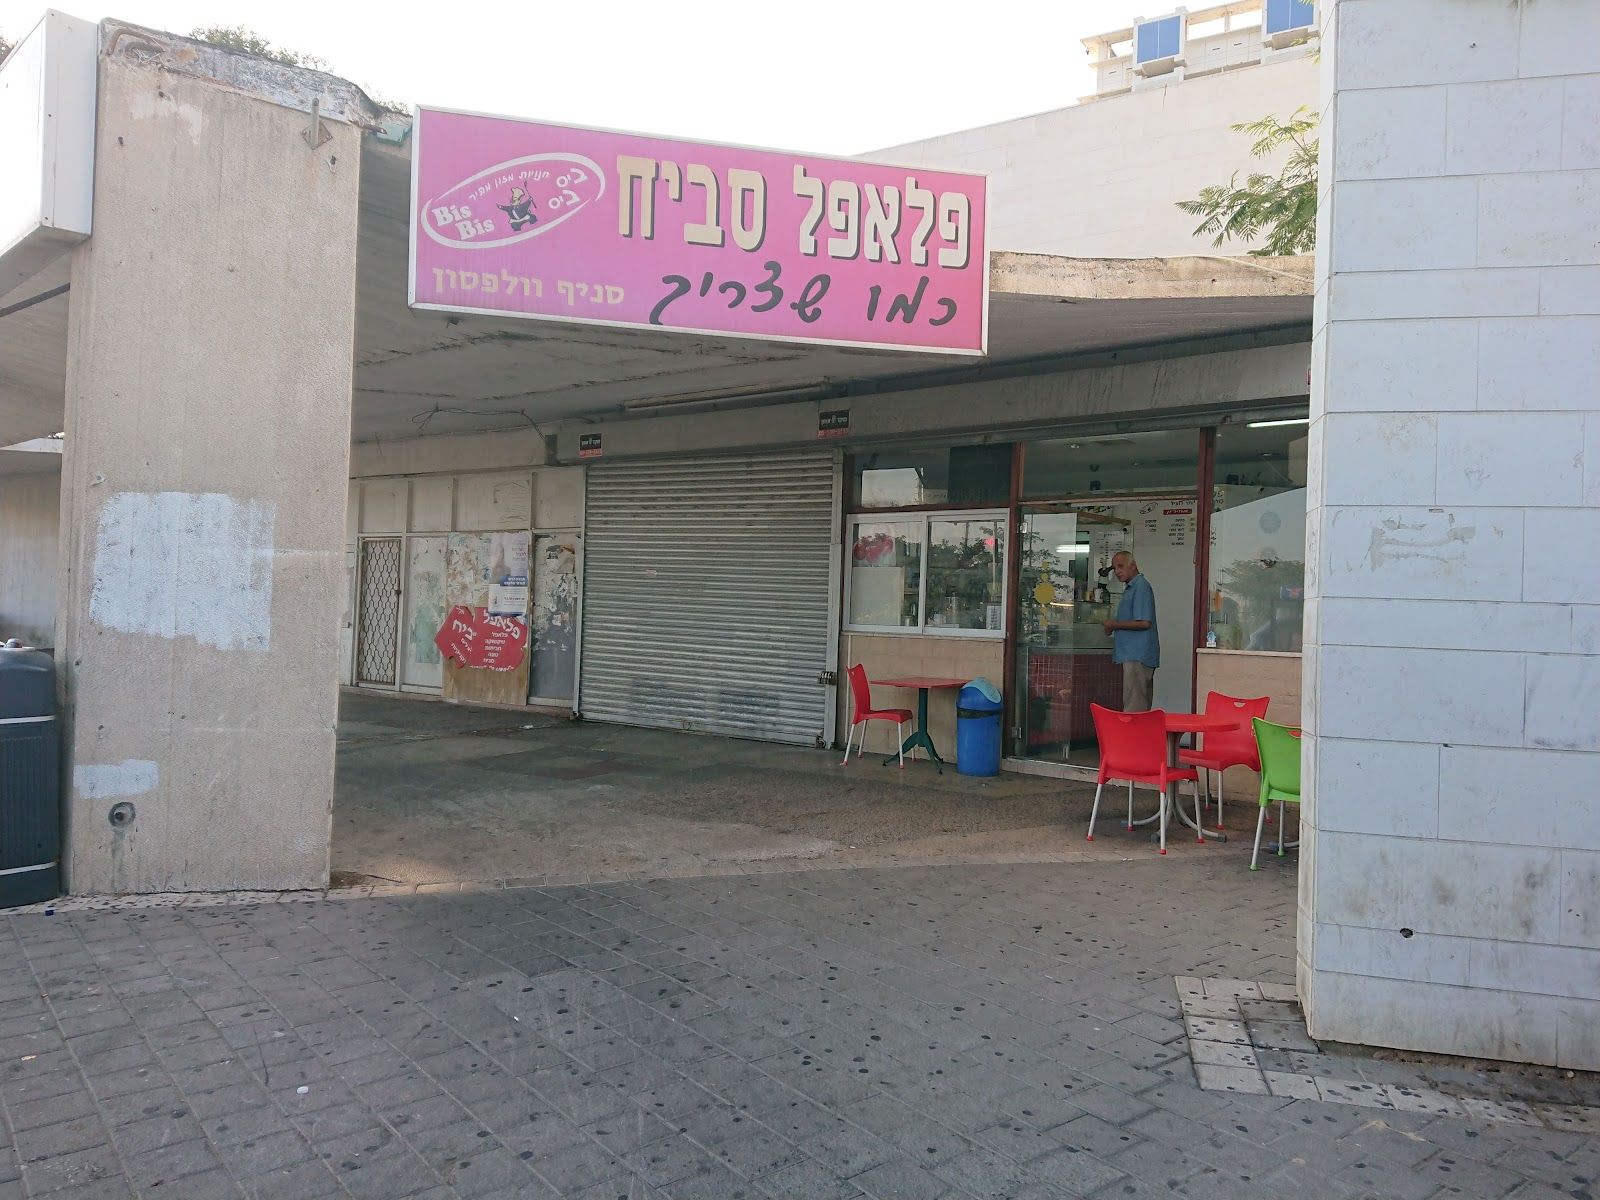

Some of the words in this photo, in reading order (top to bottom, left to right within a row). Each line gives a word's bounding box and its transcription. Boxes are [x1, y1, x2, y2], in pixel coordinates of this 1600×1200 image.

[556, 167, 588, 188] ביס
[548, 189, 580, 210] ביס
[617, 155, 767, 252] סביח
[432, 205, 472, 227] Bis
[455, 219, 495, 241] Bis
[794, 164, 971, 269] פלאפל
[432, 267, 543, 298] וולפסון
[557, 279, 625, 306] סניף
[649, 260, 831, 326] שצריך
[867, 276, 957, 326] כמו
